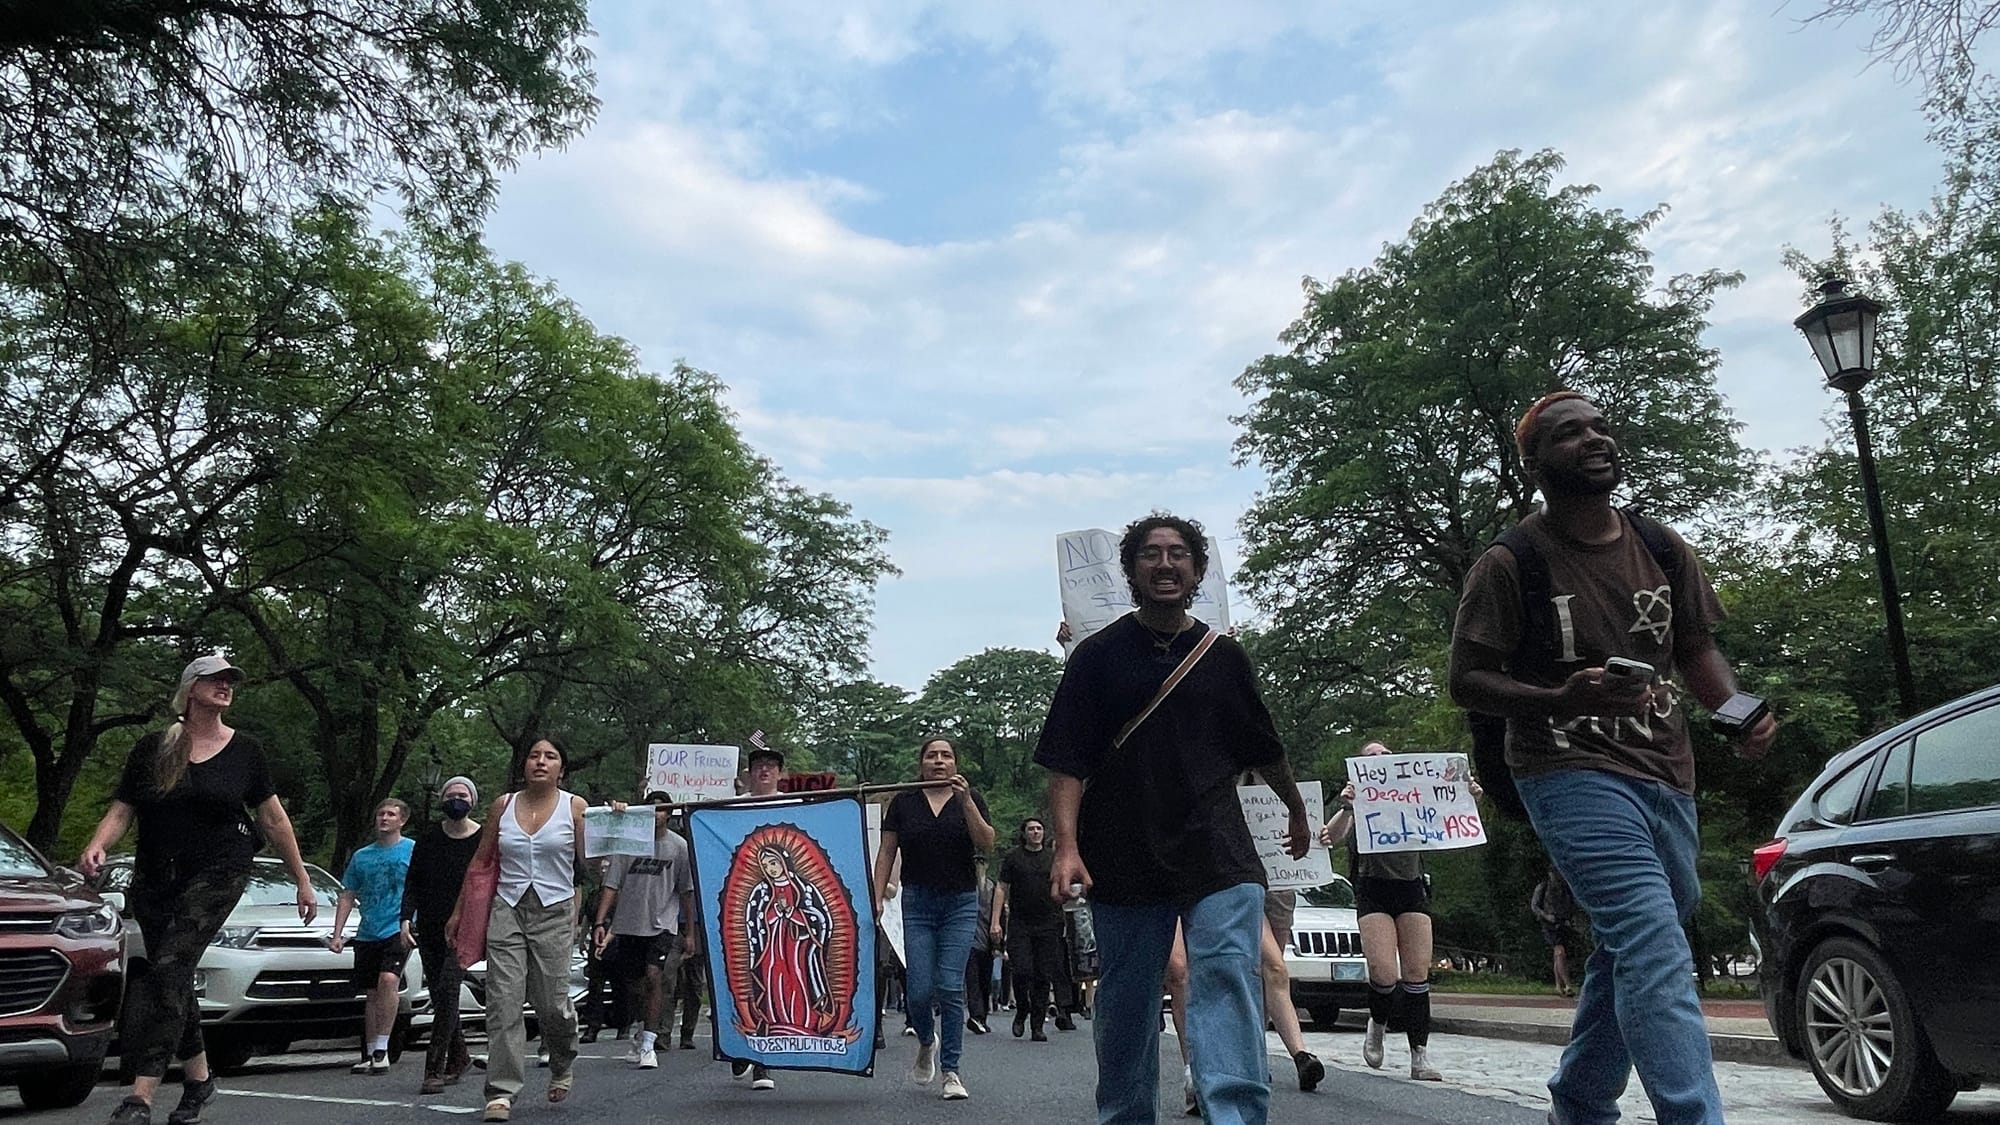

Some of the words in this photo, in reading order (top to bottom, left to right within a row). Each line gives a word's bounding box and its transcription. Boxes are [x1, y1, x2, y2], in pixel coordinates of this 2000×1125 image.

[1065, 534, 1114, 568] NO
[1065, 570, 1114, 590] being
[1550, 594, 1586, 662] I
[658, 749, 687, 768] OUR
[695, 751, 732, 768] FRIENDS
[657, 771, 681, 788] OUR
[1354, 762, 1387, 784] Hey
[1394, 760, 1440, 780] ICE,
[1365, 812, 1414, 849] Foot
[1443, 815, 1480, 839] ASS
[749, 1037, 844, 1052] INDESTRUCTIBLE
